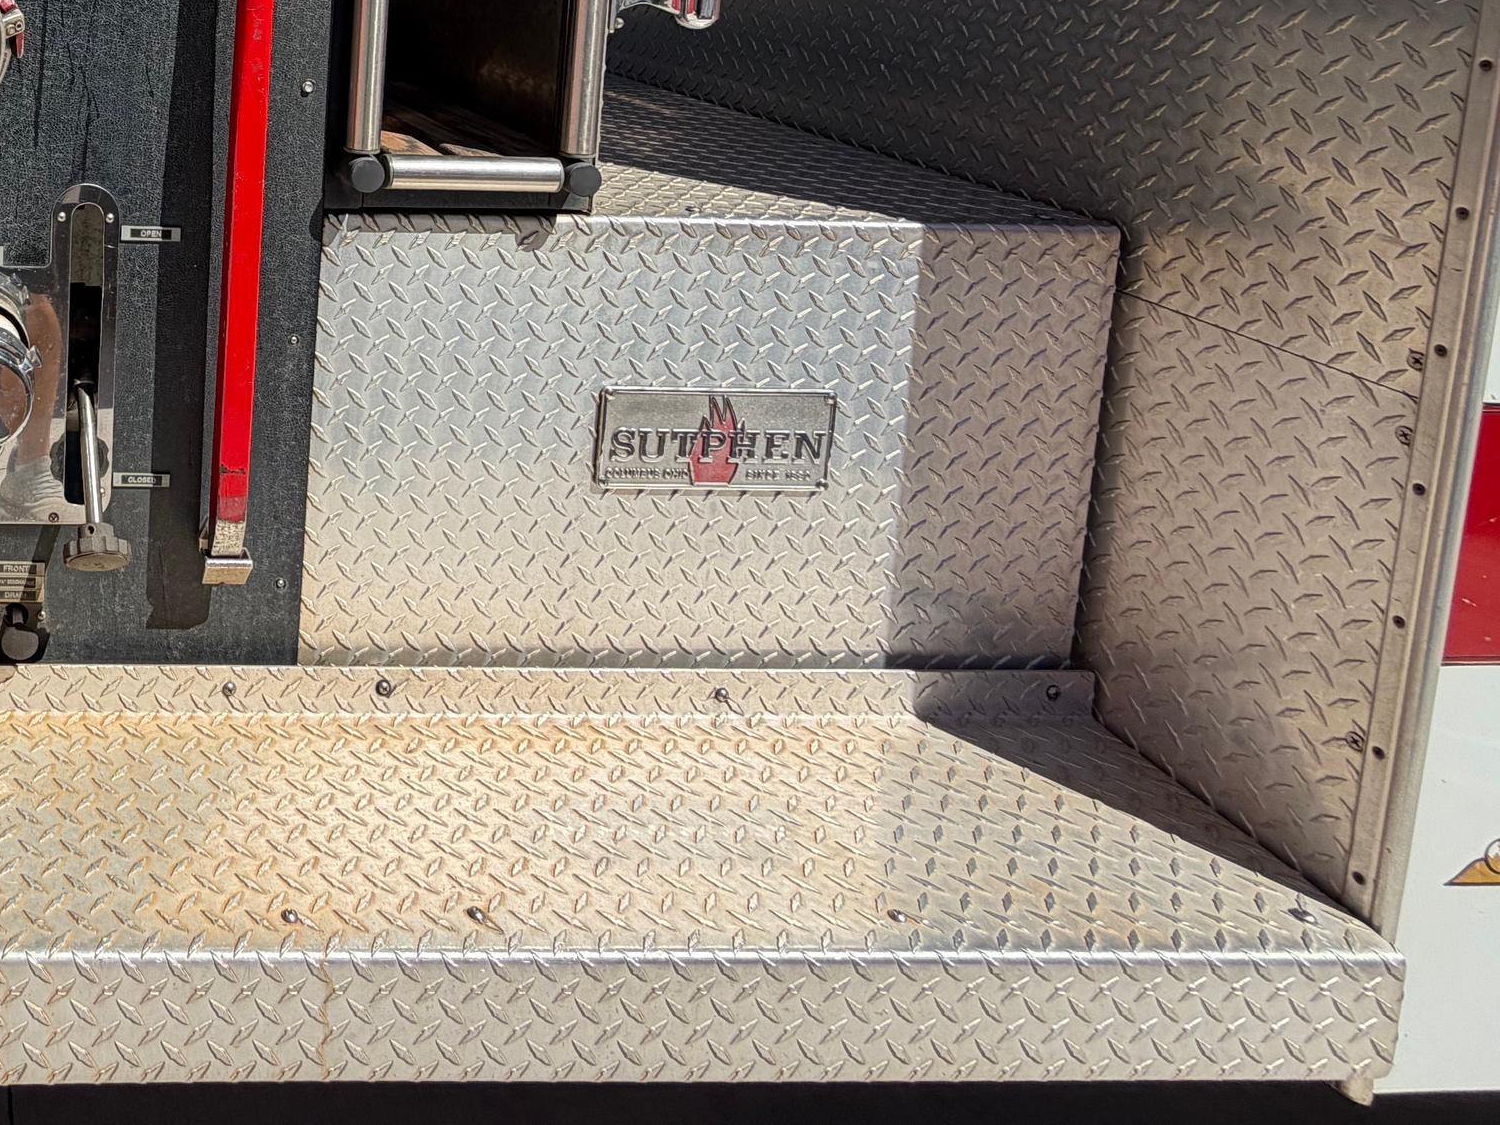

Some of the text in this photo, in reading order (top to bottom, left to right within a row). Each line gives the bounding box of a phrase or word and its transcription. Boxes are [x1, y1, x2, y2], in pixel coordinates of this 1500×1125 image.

[140, 229, 162, 238] OPEN
[610, 427, 827, 465] SUTPHEN
[746, 469, 781, 480] SINCE
[127, 475, 157, 484] CLOSED
[3, 565, 29, 573] FRONT
